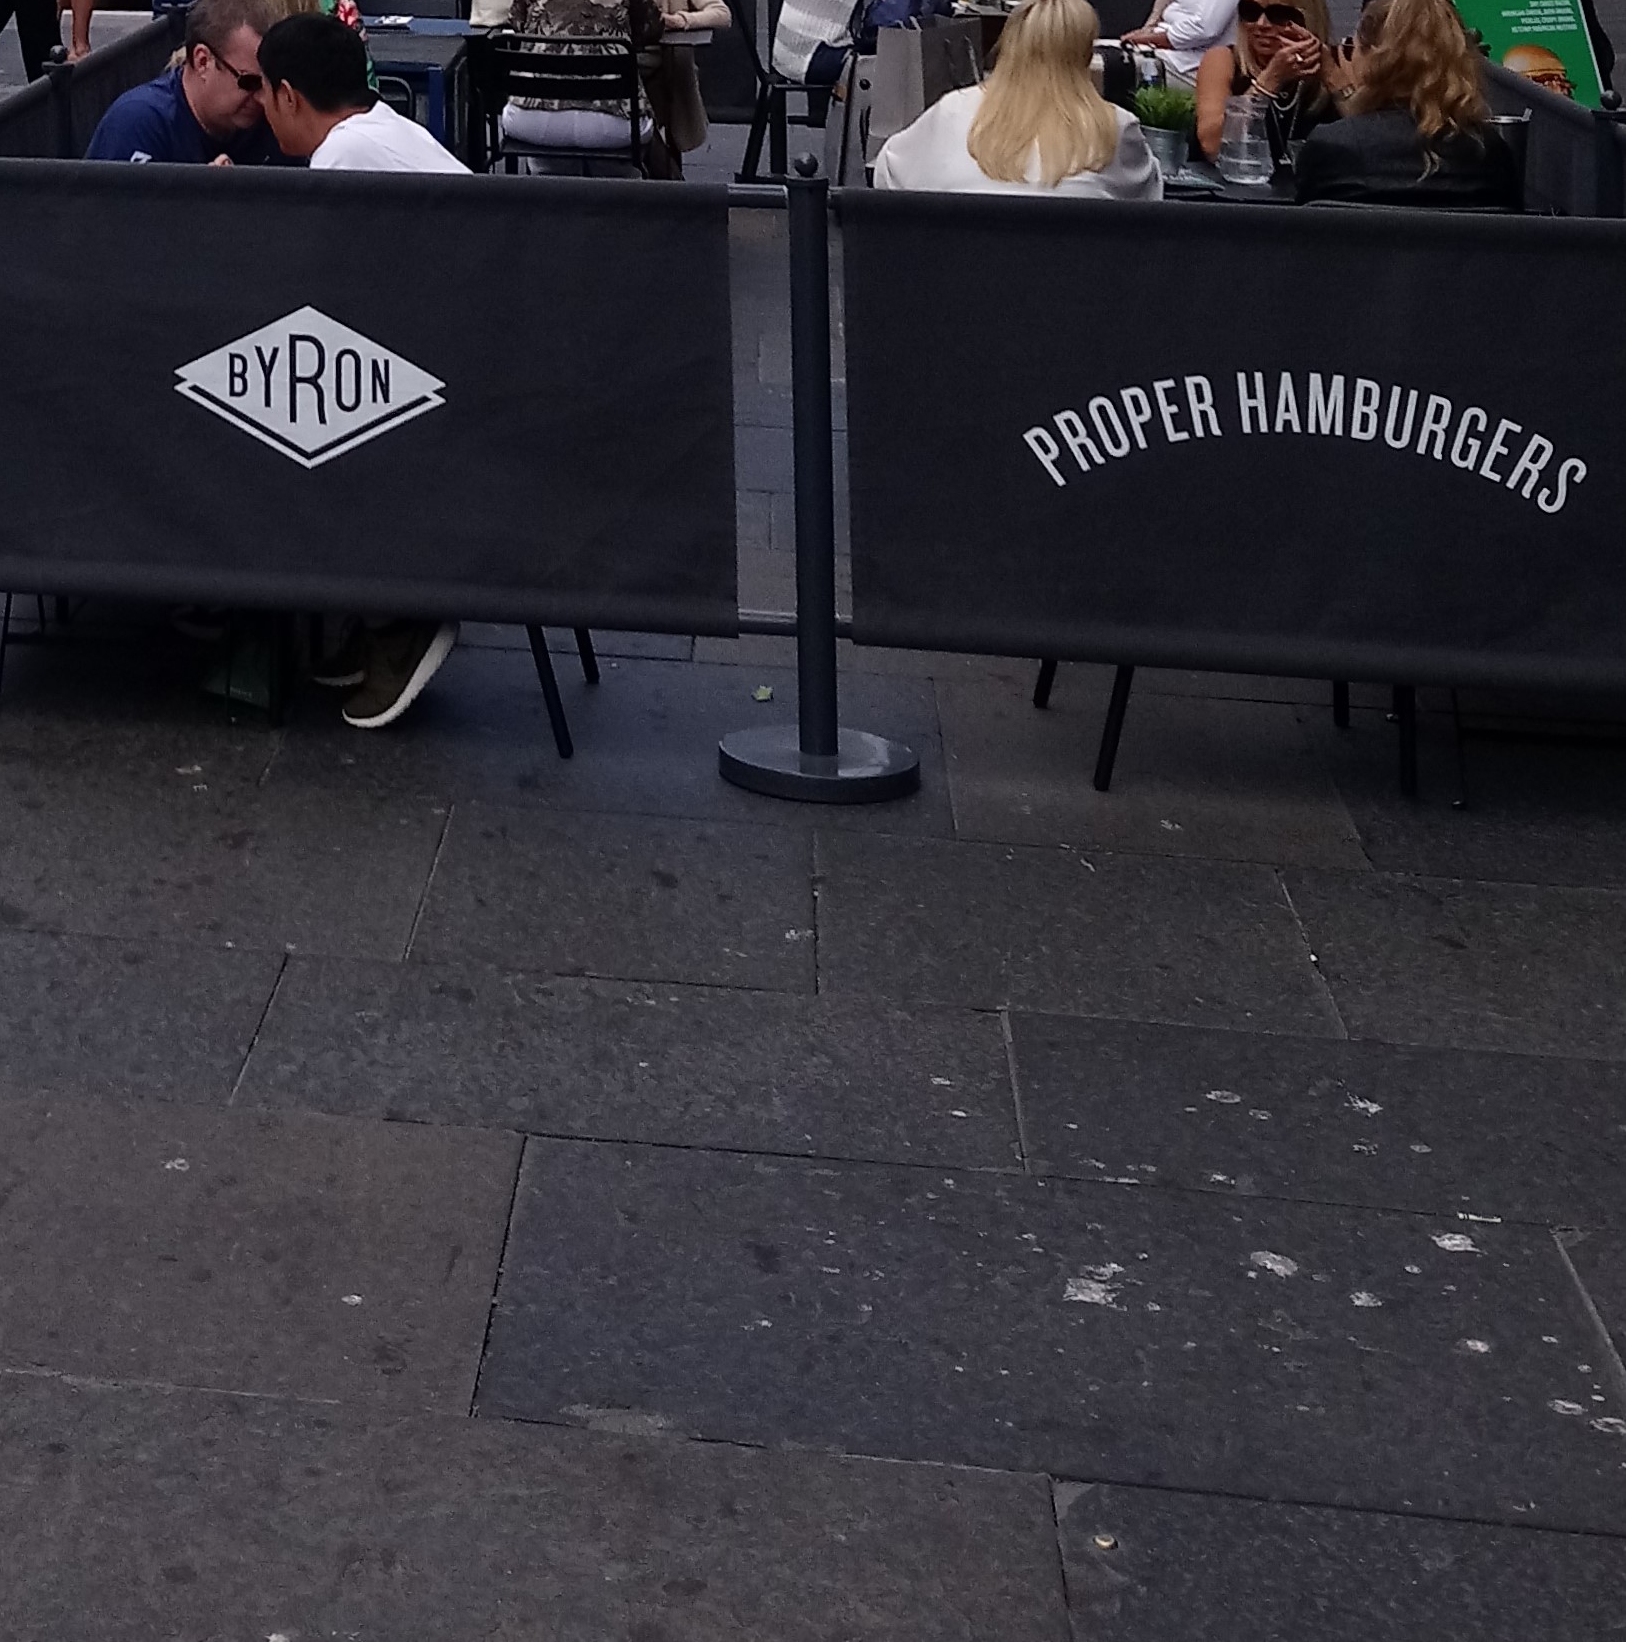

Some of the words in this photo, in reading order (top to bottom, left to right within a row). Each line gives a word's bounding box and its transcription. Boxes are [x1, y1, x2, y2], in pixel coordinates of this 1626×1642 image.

[228, 333, 391, 425] BYRON
[1023, 374, 1222, 487] PROPER
[1236, 370, 1588, 514] HAMBURGERS
